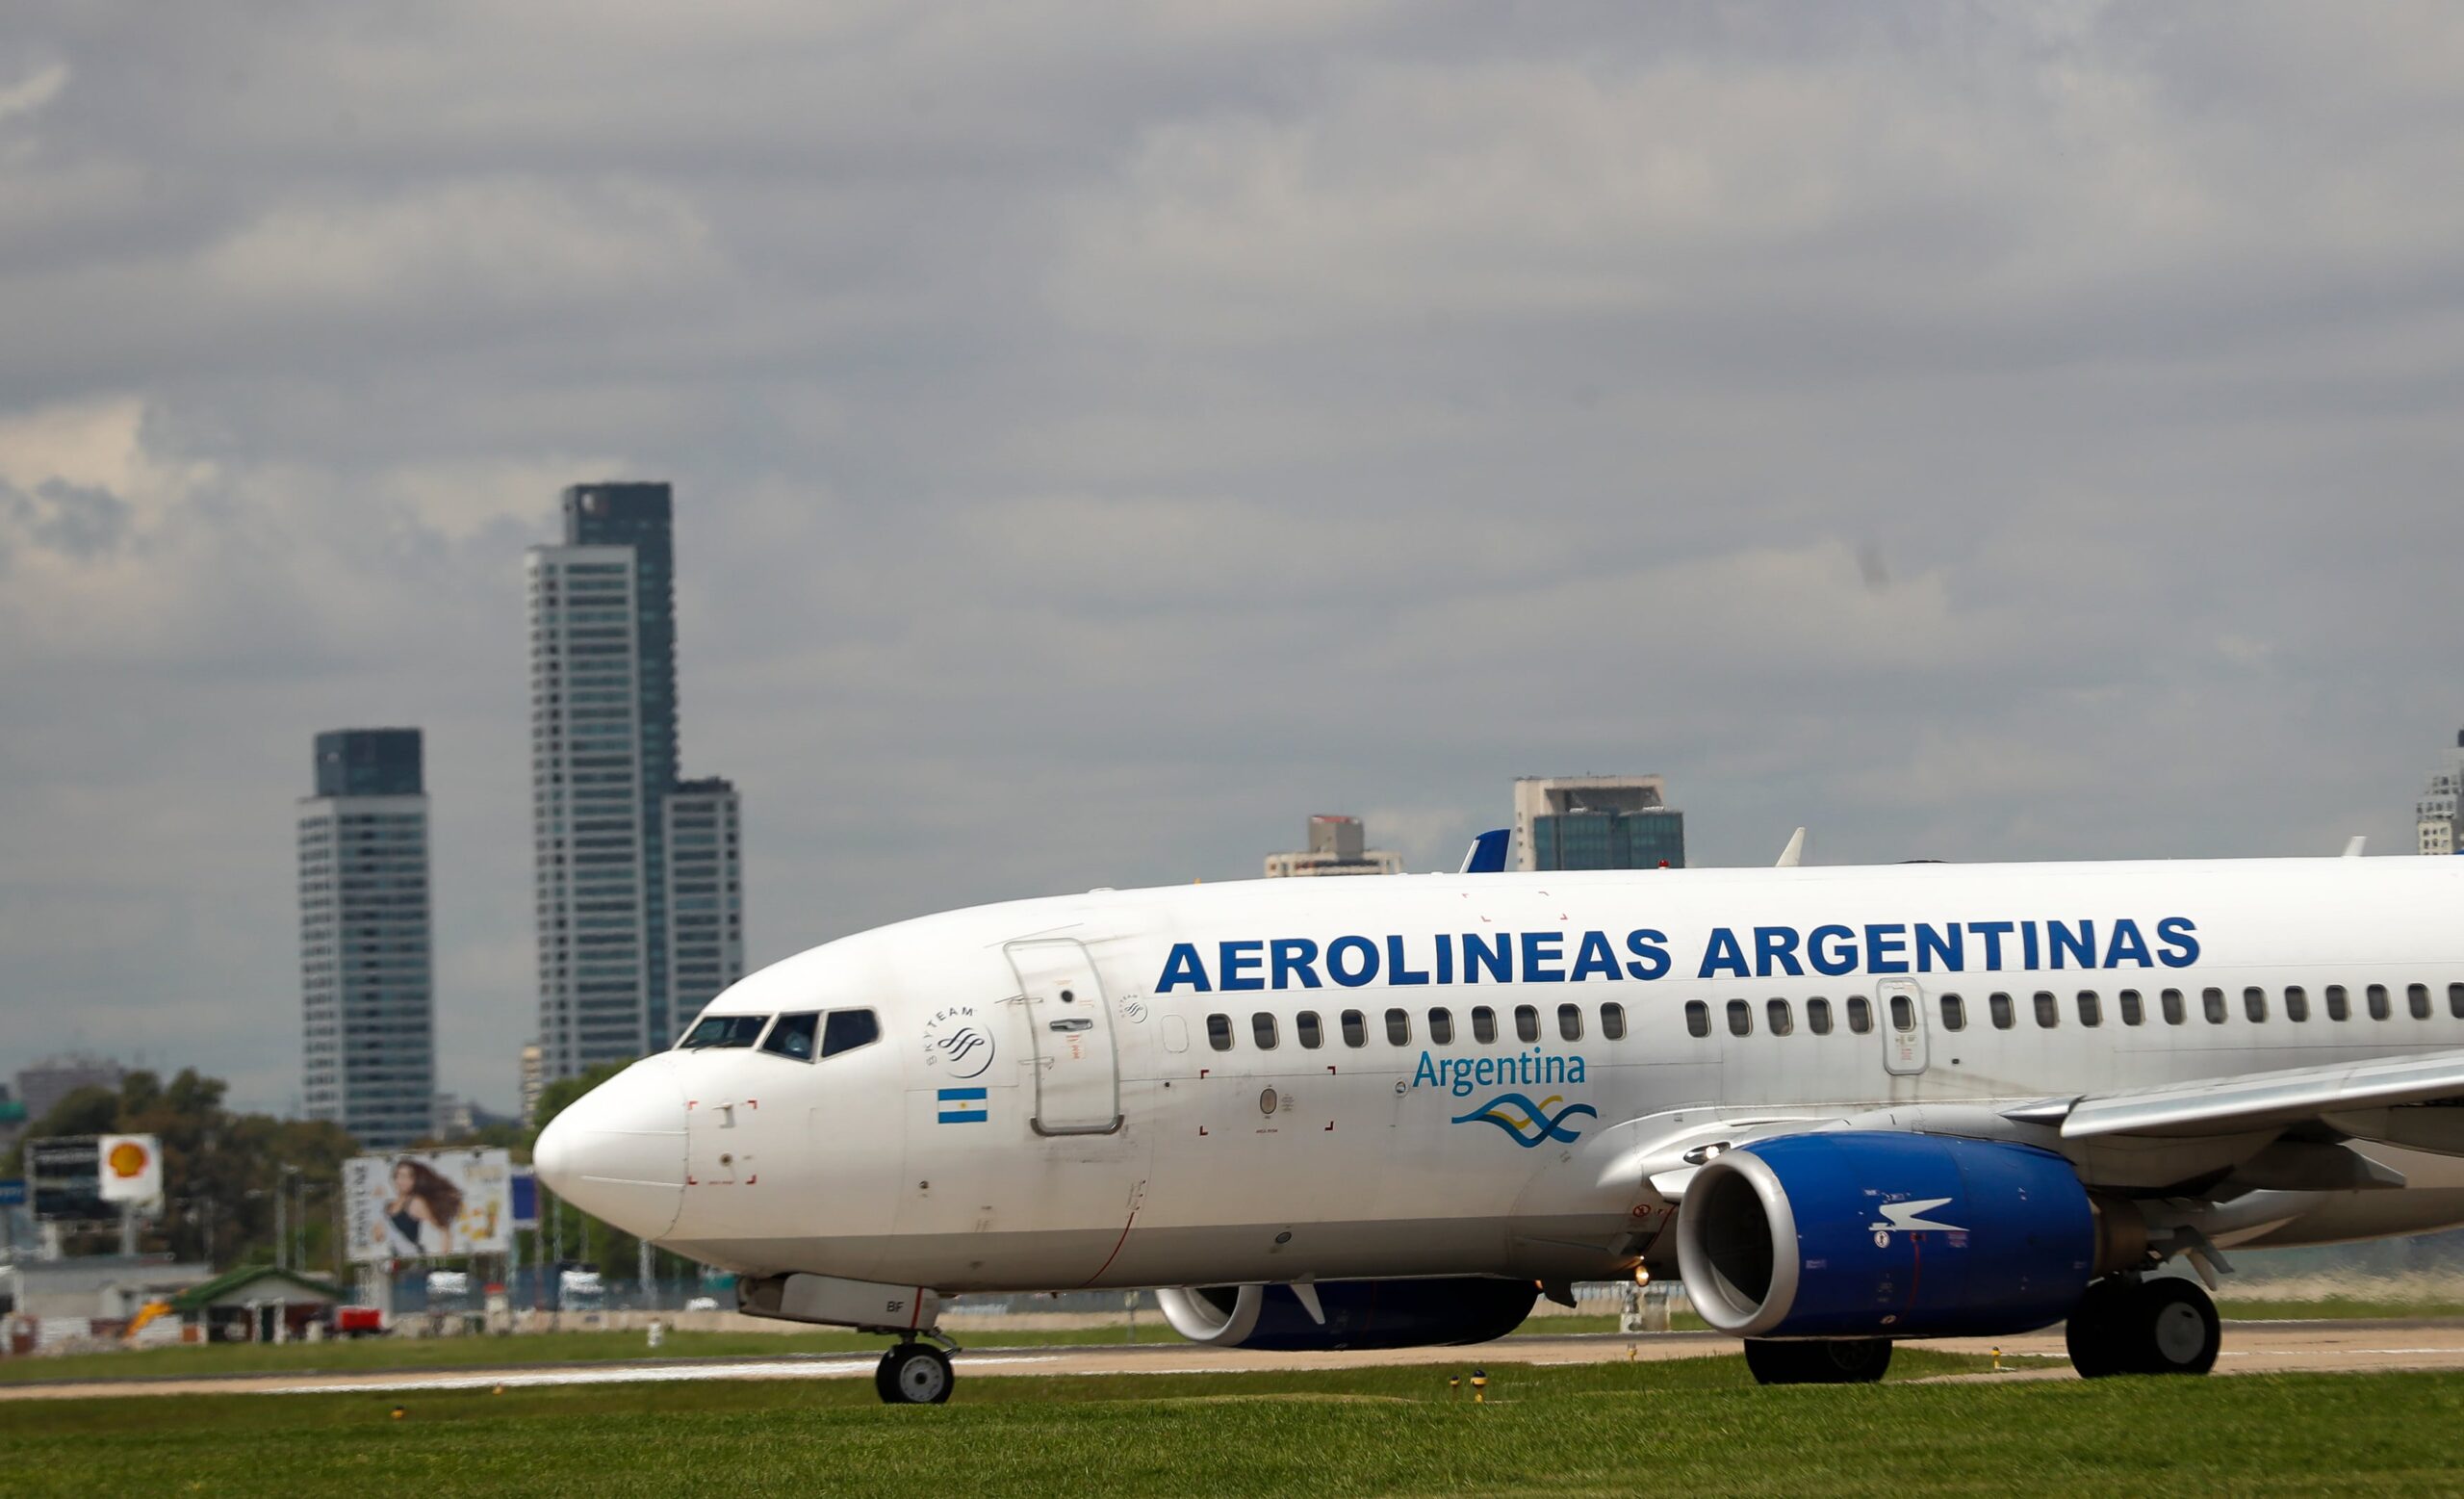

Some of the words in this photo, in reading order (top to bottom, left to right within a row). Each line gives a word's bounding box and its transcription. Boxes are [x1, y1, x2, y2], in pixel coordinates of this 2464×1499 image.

[1154, 929, 1672, 994] AEROLINEAS
[1697, 917, 2200, 978] ARGENTINAS
[1412, 1047, 1585, 1097] Argentina
[886, 1301, 905, 1312] BF
